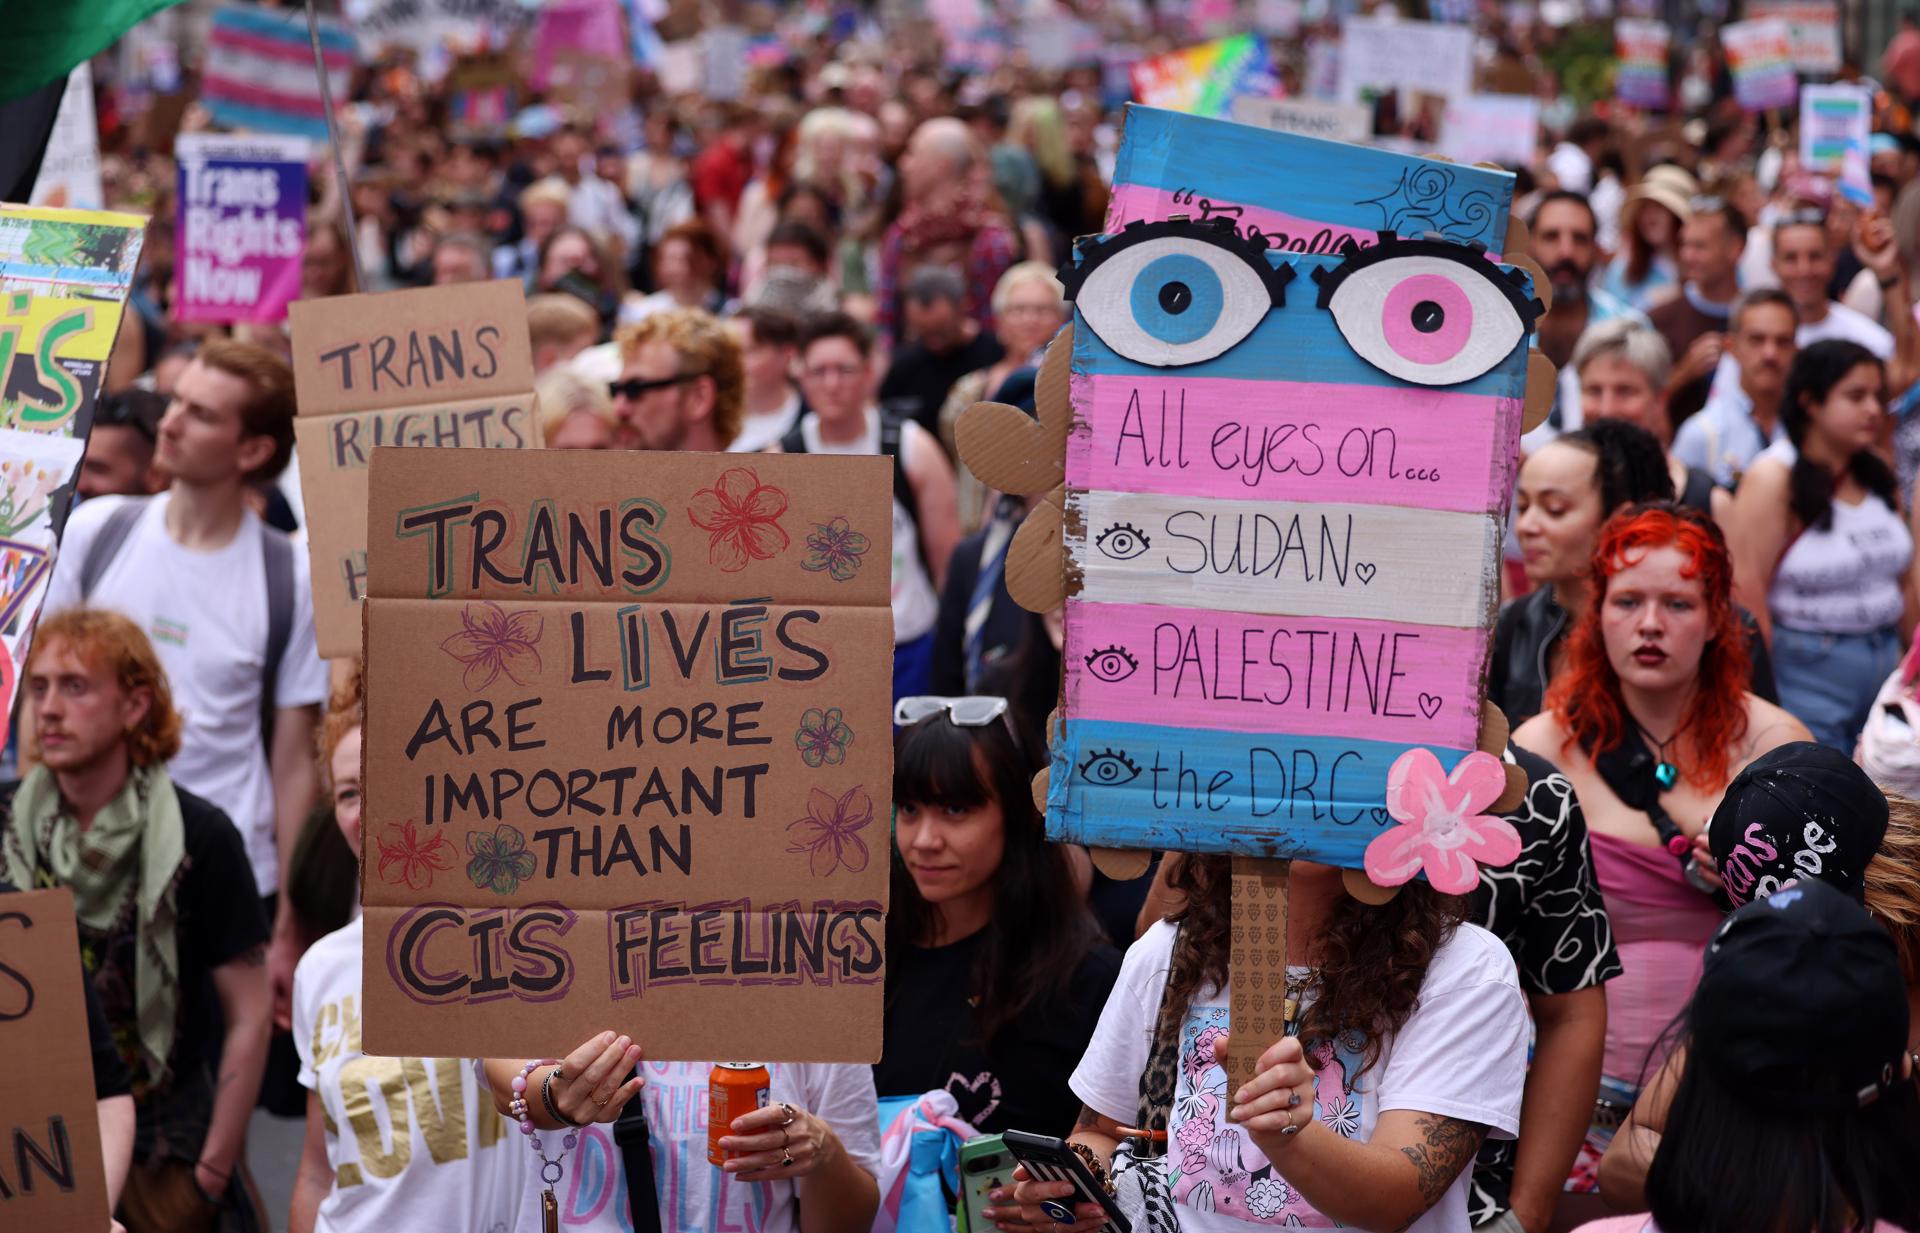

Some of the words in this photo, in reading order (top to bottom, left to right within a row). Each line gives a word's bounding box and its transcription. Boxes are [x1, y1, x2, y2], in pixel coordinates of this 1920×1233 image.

[184, 160, 280, 207] Trans
[184, 206, 301, 265] Rights
[184, 255, 263, 306] Now
[320, 326, 501, 391] TRANS
[333, 406, 525, 467] RIGHTS
[1115, 388, 1190, 468] All
[1211, 422, 1325, 487] eyes
[401, 502, 664, 592] TRANS
[570, 602, 830, 685] LIVES
[405, 697, 547, 760] ARE
[607, 702, 773, 750] MORE
[425, 763, 770, 824] IMPORTANT
[1151, 751, 1234, 811] the
[533, 824, 691, 878] THAN
[396, 907, 570, 998] CIS
[613, 903, 886, 988] FEELINGS
